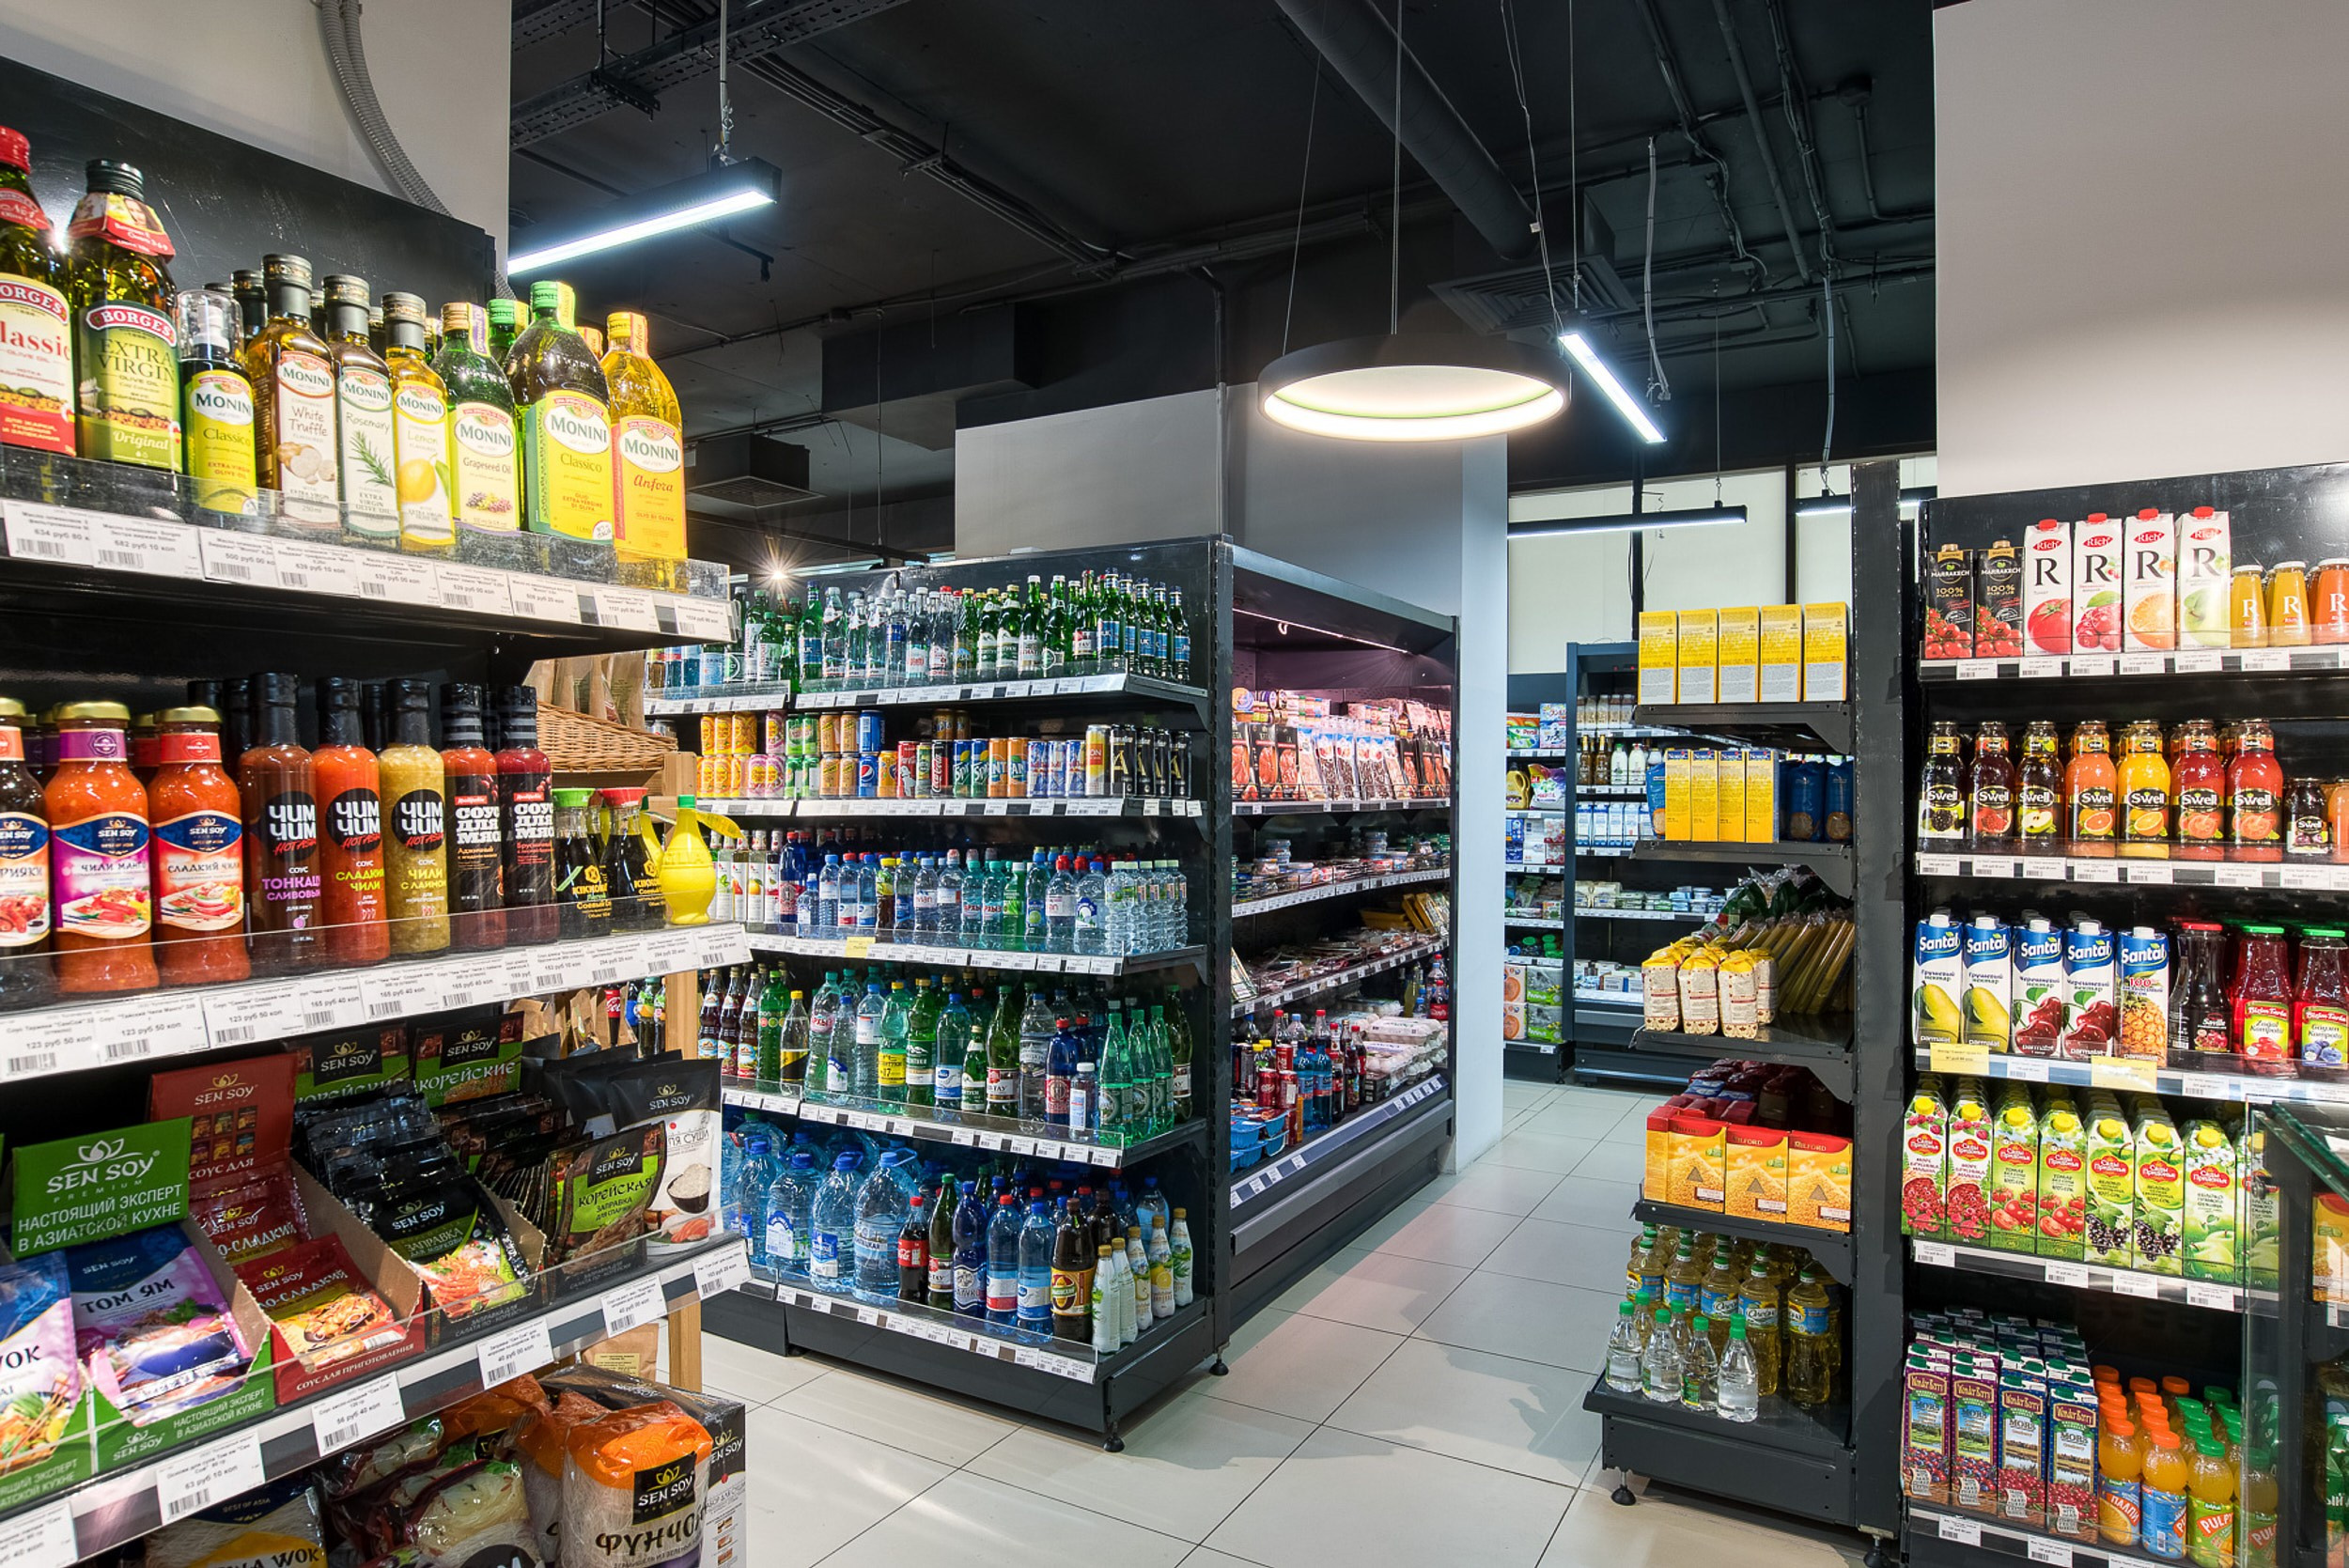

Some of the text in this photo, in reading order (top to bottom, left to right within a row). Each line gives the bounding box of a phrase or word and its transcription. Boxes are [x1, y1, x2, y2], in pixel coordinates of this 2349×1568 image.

[101, 310, 174, 338] BORGES
[100, 338, 173, 365] EXTRA
[98, 354, 176, 383] VIRGIN
[283, 366, 331, 388] MONINI
[344, 380, 390, 402] MONINI
[291, 406, 325, 422] White
[399, 396, 443, 414] MONINI
[288, 418, 329, 438] Truffle
[346, 411, 391, 434] Rosemary
[551, 413, 608, 443] MONINI
[113, 430, 169, 450] Original
[203, 427, 251, 447] Classico
[408, 430, 439, 445] Lemon
[459, 425, 512, 448] MONINI
[624, 438, 679, 462] MONINI
[463, 457, 500, 473] Grapeseed
[561, 453, 602, 474] Classico
[633, 474, 675, 493] Anfora
[2086, 536, 2110, 547] Rich
[2138, 534, 2162, 543] Rich
[2194, 530, 2217, 540] Rich
[132, 542, 148, 551] руб
[2037, 542, 2058, 551] Rich
[2034, 557, 2061, 586] R
[2085, 554, 2113, 583] R
[2136, 551, 2165, 581] R
[2192, 547, 2221, 578] R
[2242, 598, 2260, 618] R
[2283, 596, 2301, 615] R
[2329, 593, 2348, 613] R
[1926, 791, 1958, 802] Swell
[1979, 791, 2010, 802] Swell
[2019, 791, 2050, 802] Swell
[2081, 791, 2114, 803] Swell
[2131, 792, 2165, 805] Swell
[2181, 793, 2217, 806] Swell
[2234, 793, 2272, 806] Swell
[2298, 820, 2323, 829] Swell
[408, 868, 443, 880] ЧИЛИ
[350, 881, 381, 892] ЧИЛИ
[324, 998, 336, 1007] руб
[243, 1012, 257, 1021] руб
[121, 1028, 135, 1036] 123
[138, 1026, 153, 1035] руб
[44, 1039, 61, 1049] руб
[447, 1037, 494, 1057] SEN SOY
[320, 1052, 374, 1072] SEN SOY
[418, 1062, 517, 1094] КОРЕЙСКИЕ
[194, 1084, 254, 1105] SEN SOY
[649, 1095, 692, 1110] SEN SOY
[226, 1157, 255, 1173] ДЛЯ
[596, 1155, 636, 1175] SEN SOY
[47, 1157, 155, 1194] SEN SOY
[54, 1179, 143, 1203] PREMIUM
[578, 1176, 654, 1208] КОРЕЙСКАЯ
[18, 1183, 183, 1234] НАСТОЯЩИЙ ЭКСПЕРТ
[392, 1204, 445, 1231] SEN SOY
[18, 1202, 181, 1252] В АЗИАТСКОЙ КУХНЕ
[256, 1271, 303, 1294] SEN SOY
[80, 1279, 176, 1314] ТОМ ЯМ
[296, 1343, 414, 1391] СОУС ДЛЯ ПРИГОТОВЛЕНИЯ
[173, 1388, 265, 1429] НАСТОЯЩИЙ ЭКСПЕРТ
[177, 1400, 264, 1438] В АЗИАТСКОЙ КУХНЕ
[710, 1438, 743, 1464] EN SOY
[196, 1475, 210, 1486] руб
[225, 1466, 239, 1475] коп
[638, 1476, 693, 1507] SEN SOY
[2110, 1495, 2139, 1523] ПАЛПИ
[2200, 1512, 2233, 1533] PULPY
[272, 1547, 319, 1566] WOK
